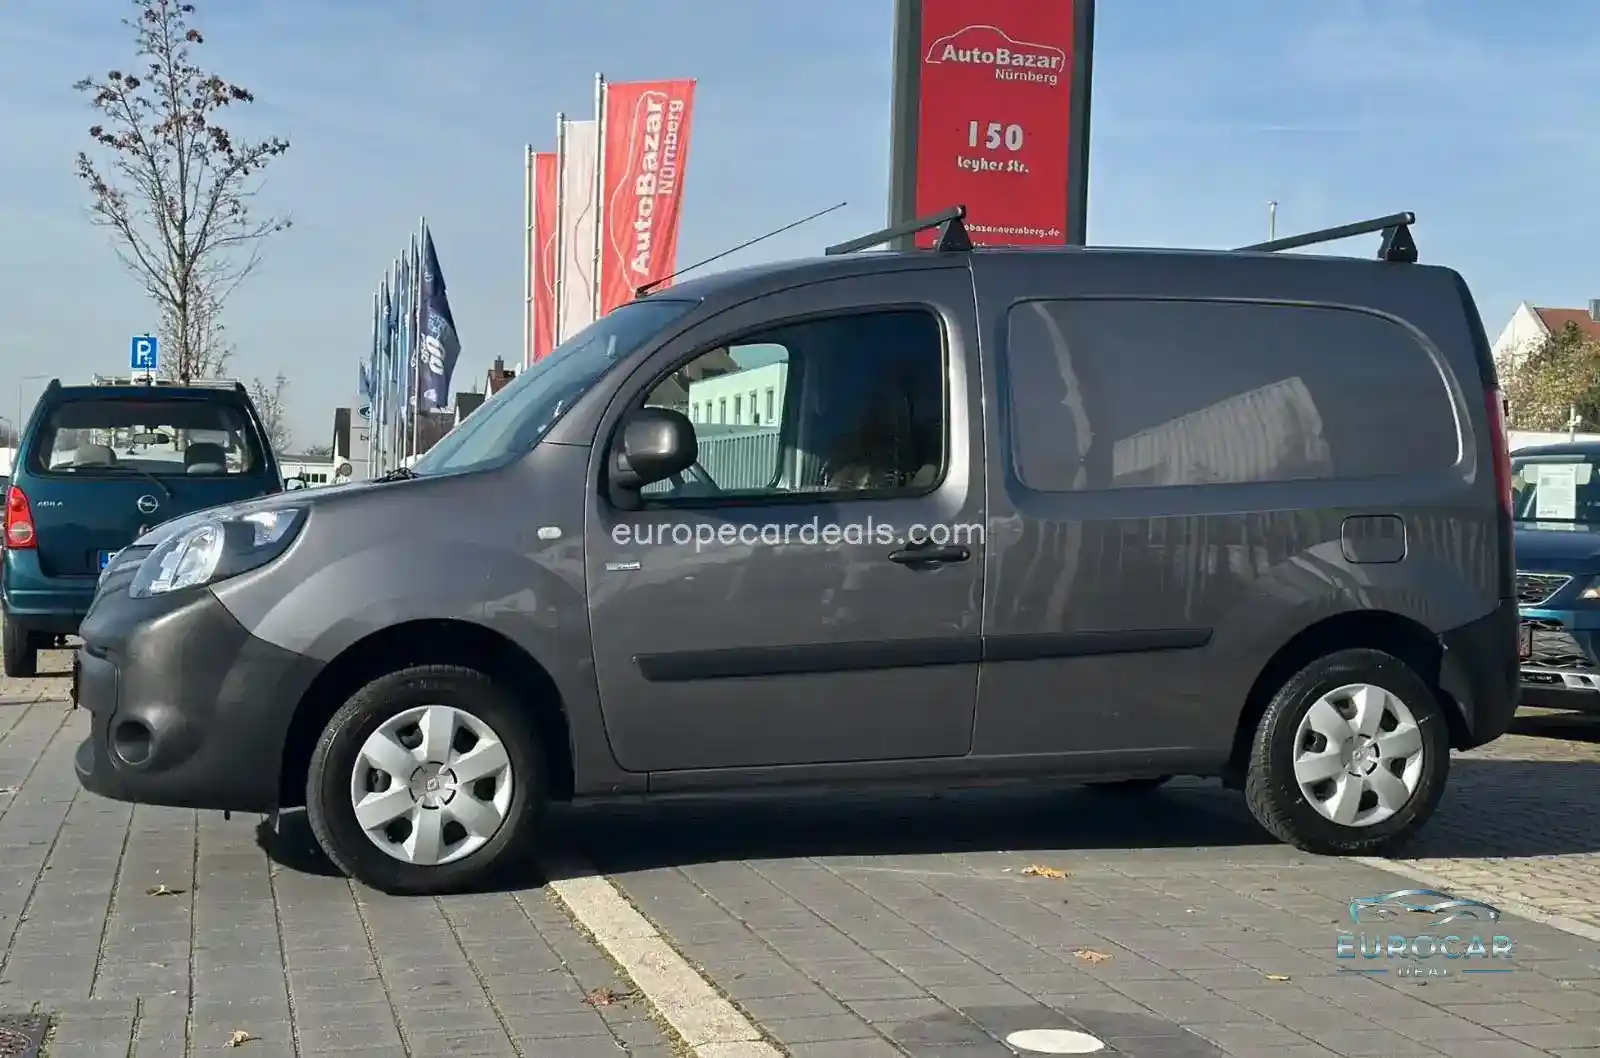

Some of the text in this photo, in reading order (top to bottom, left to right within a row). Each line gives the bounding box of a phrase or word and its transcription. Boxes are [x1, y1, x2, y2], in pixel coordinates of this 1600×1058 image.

[942, 45, 1061, 69] AutoBazar
[995, 69, 1058, 85] Nürnberg
[968, 120, 1024, 151] 150
[1007, 160, 1030, 173] Str.
[631, 98, 664, 276] AutoBazar
[964, 224, 1060, 238] obazar-nuernberg.de
[136, 340, 152, 366] P
